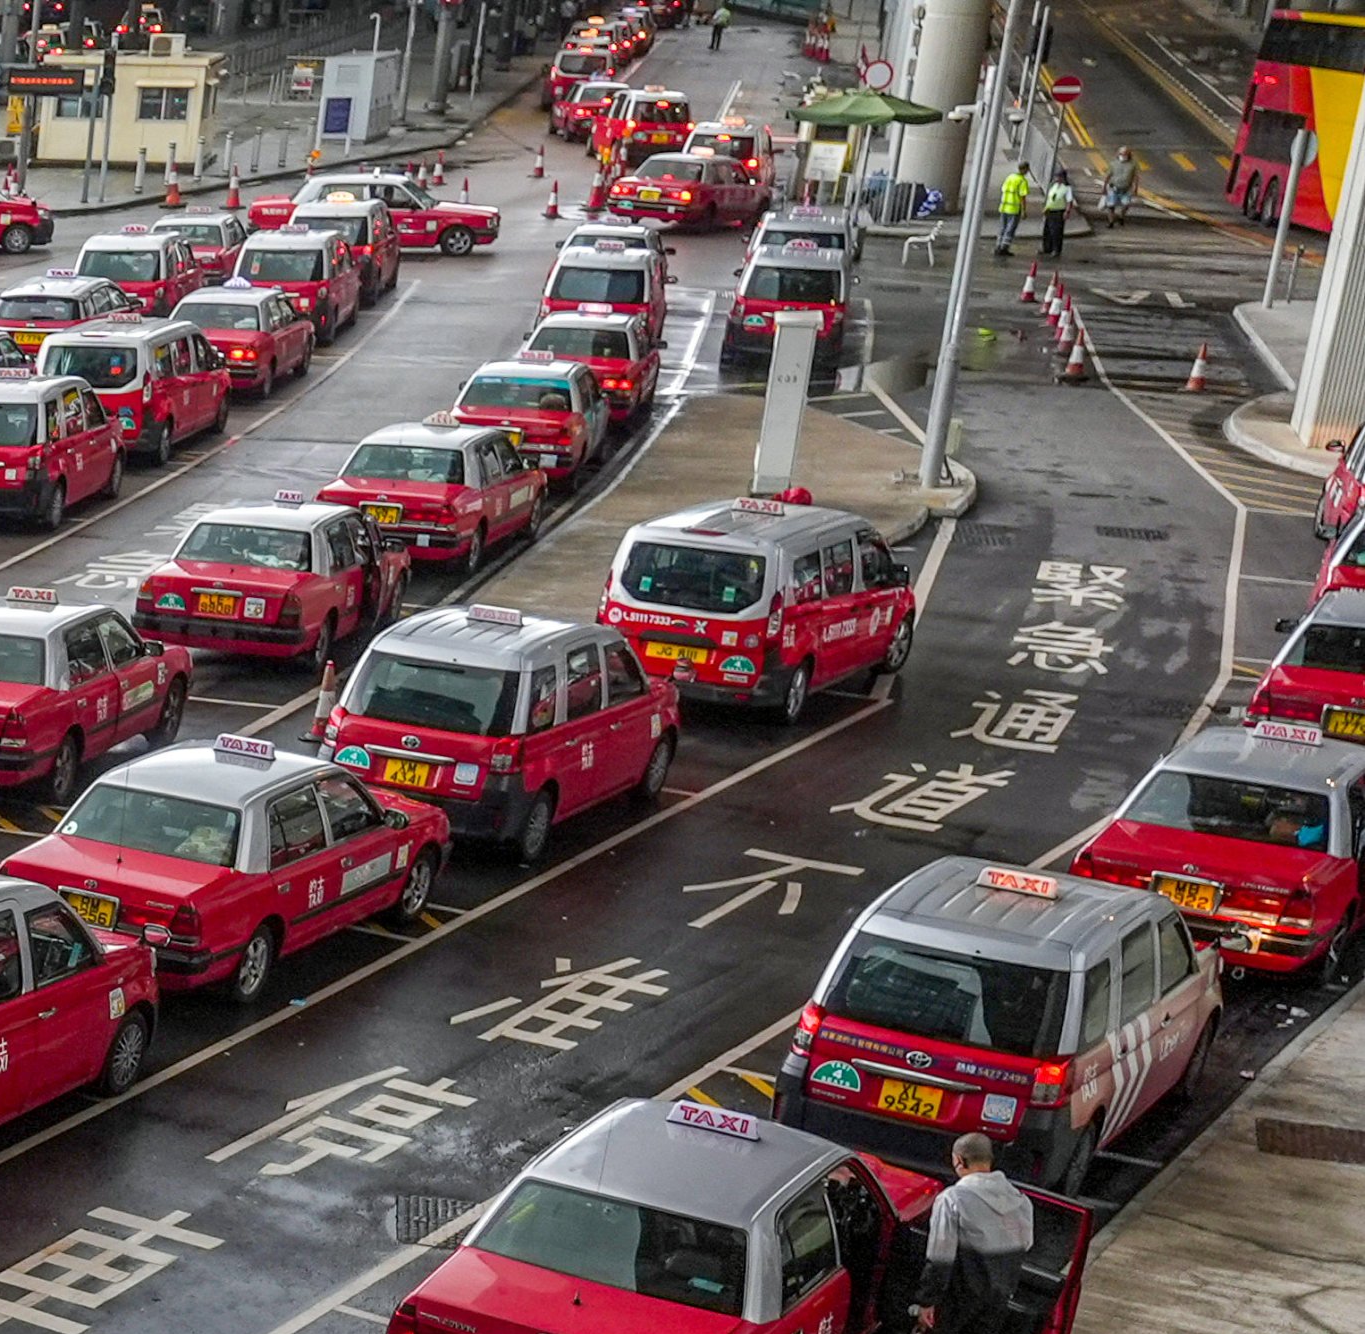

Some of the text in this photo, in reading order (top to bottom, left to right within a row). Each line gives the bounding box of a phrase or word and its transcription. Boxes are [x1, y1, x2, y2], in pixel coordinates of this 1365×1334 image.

[279, 492, 300, 501] TAXI
[739, 500, 779, 512] TAXI
[12, 588, 52, 600] TAXI
[1261, 725, 1318, 742] TAXI
[220, 739, 267, 755] TAXI
[988, 870, 1049, 894] TAXI
[829, 1061, 852, 1073] TAXI
[833, 1069, 842, 1080] 4
[821, 1075, 852, 1089] SEATS
[898, 1082, 921, 1099] XL
[885, 1096, 935, 1118] 9542
[680, 1104, 749, 1133] TAXI
